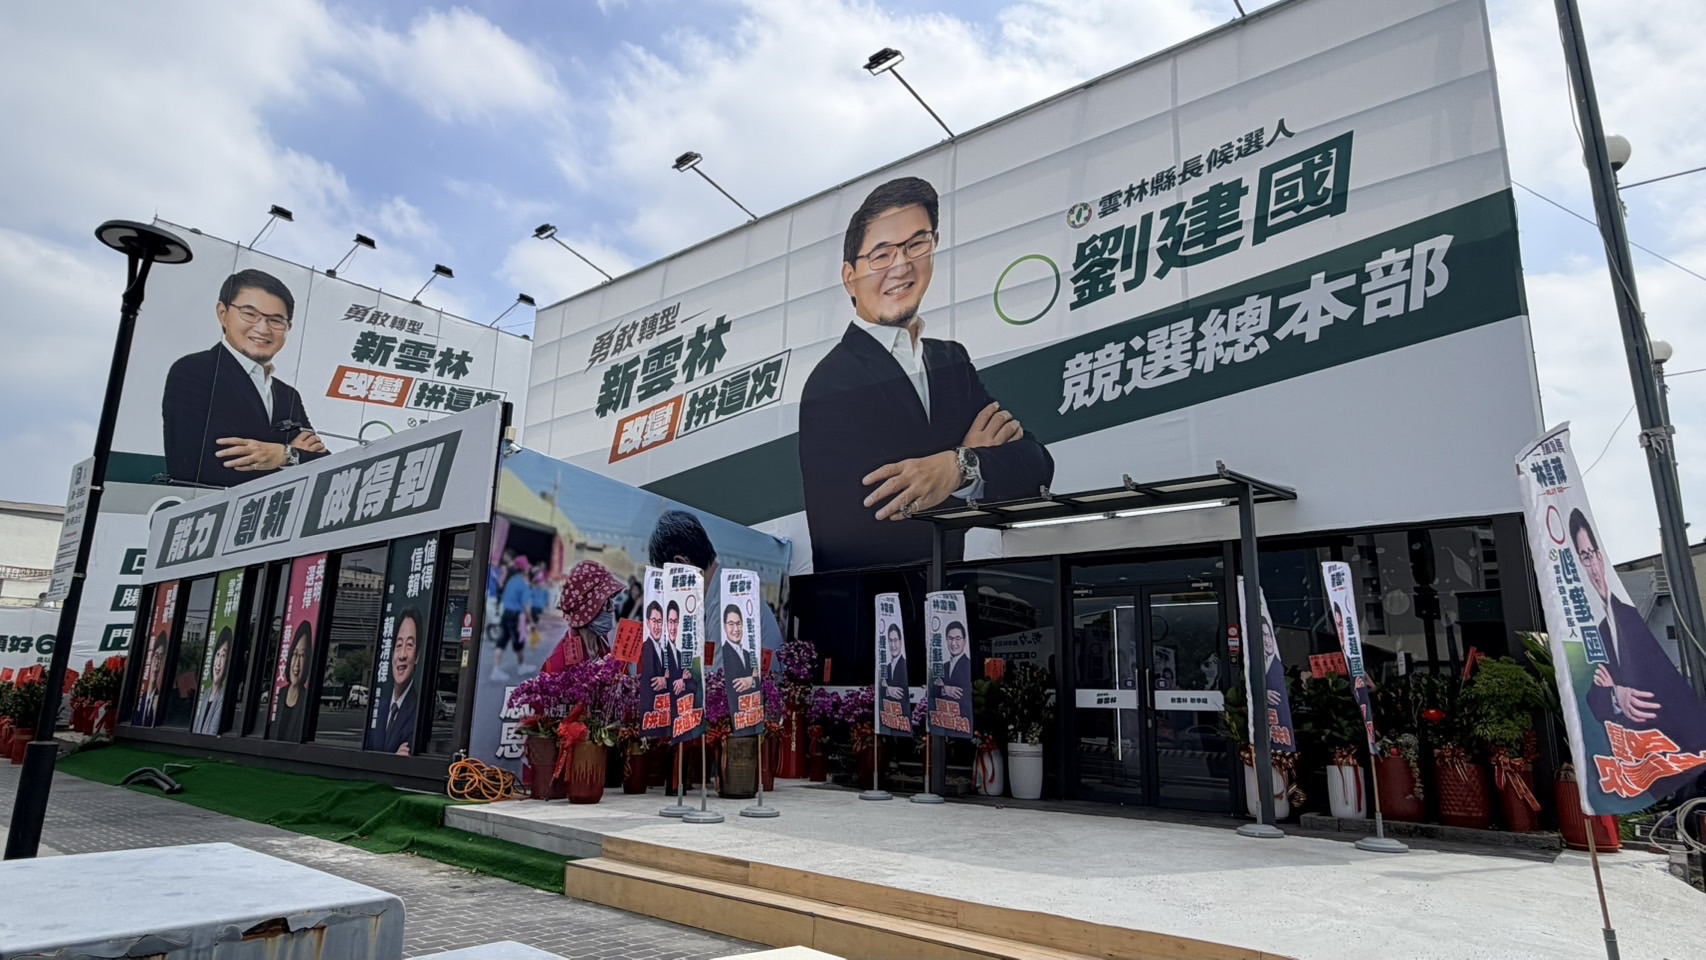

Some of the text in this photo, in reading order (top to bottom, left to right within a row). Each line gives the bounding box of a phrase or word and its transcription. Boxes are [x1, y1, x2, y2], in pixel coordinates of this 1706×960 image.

[1097, 117, 1296, 219] 雲林縣長候選人
[1069, 129, 1354, 312] 劉建國
[339, 303, 424, 336] 勇敢轉型
[583, 301, 681, 375] 勇敢轉型
[1057, 233, 1455, 416] 競選總本部
[350, 330, 474, 381] 新雲林
[595, 314, 733, 420] 新雲林
[337, 371, 405, 403] 改變
[617, 401, 676, 456] 改變
[165, 441, 445, 564] 能力 創新 做得到
[406, 548, 423, 598] 信賴
[420, 539, 438, 590] 值得
[672, 573, 696, 588] 新雲林
[377, 617, 395, 682] 賴清德
[681, 615, 694, 669] 劉建國
